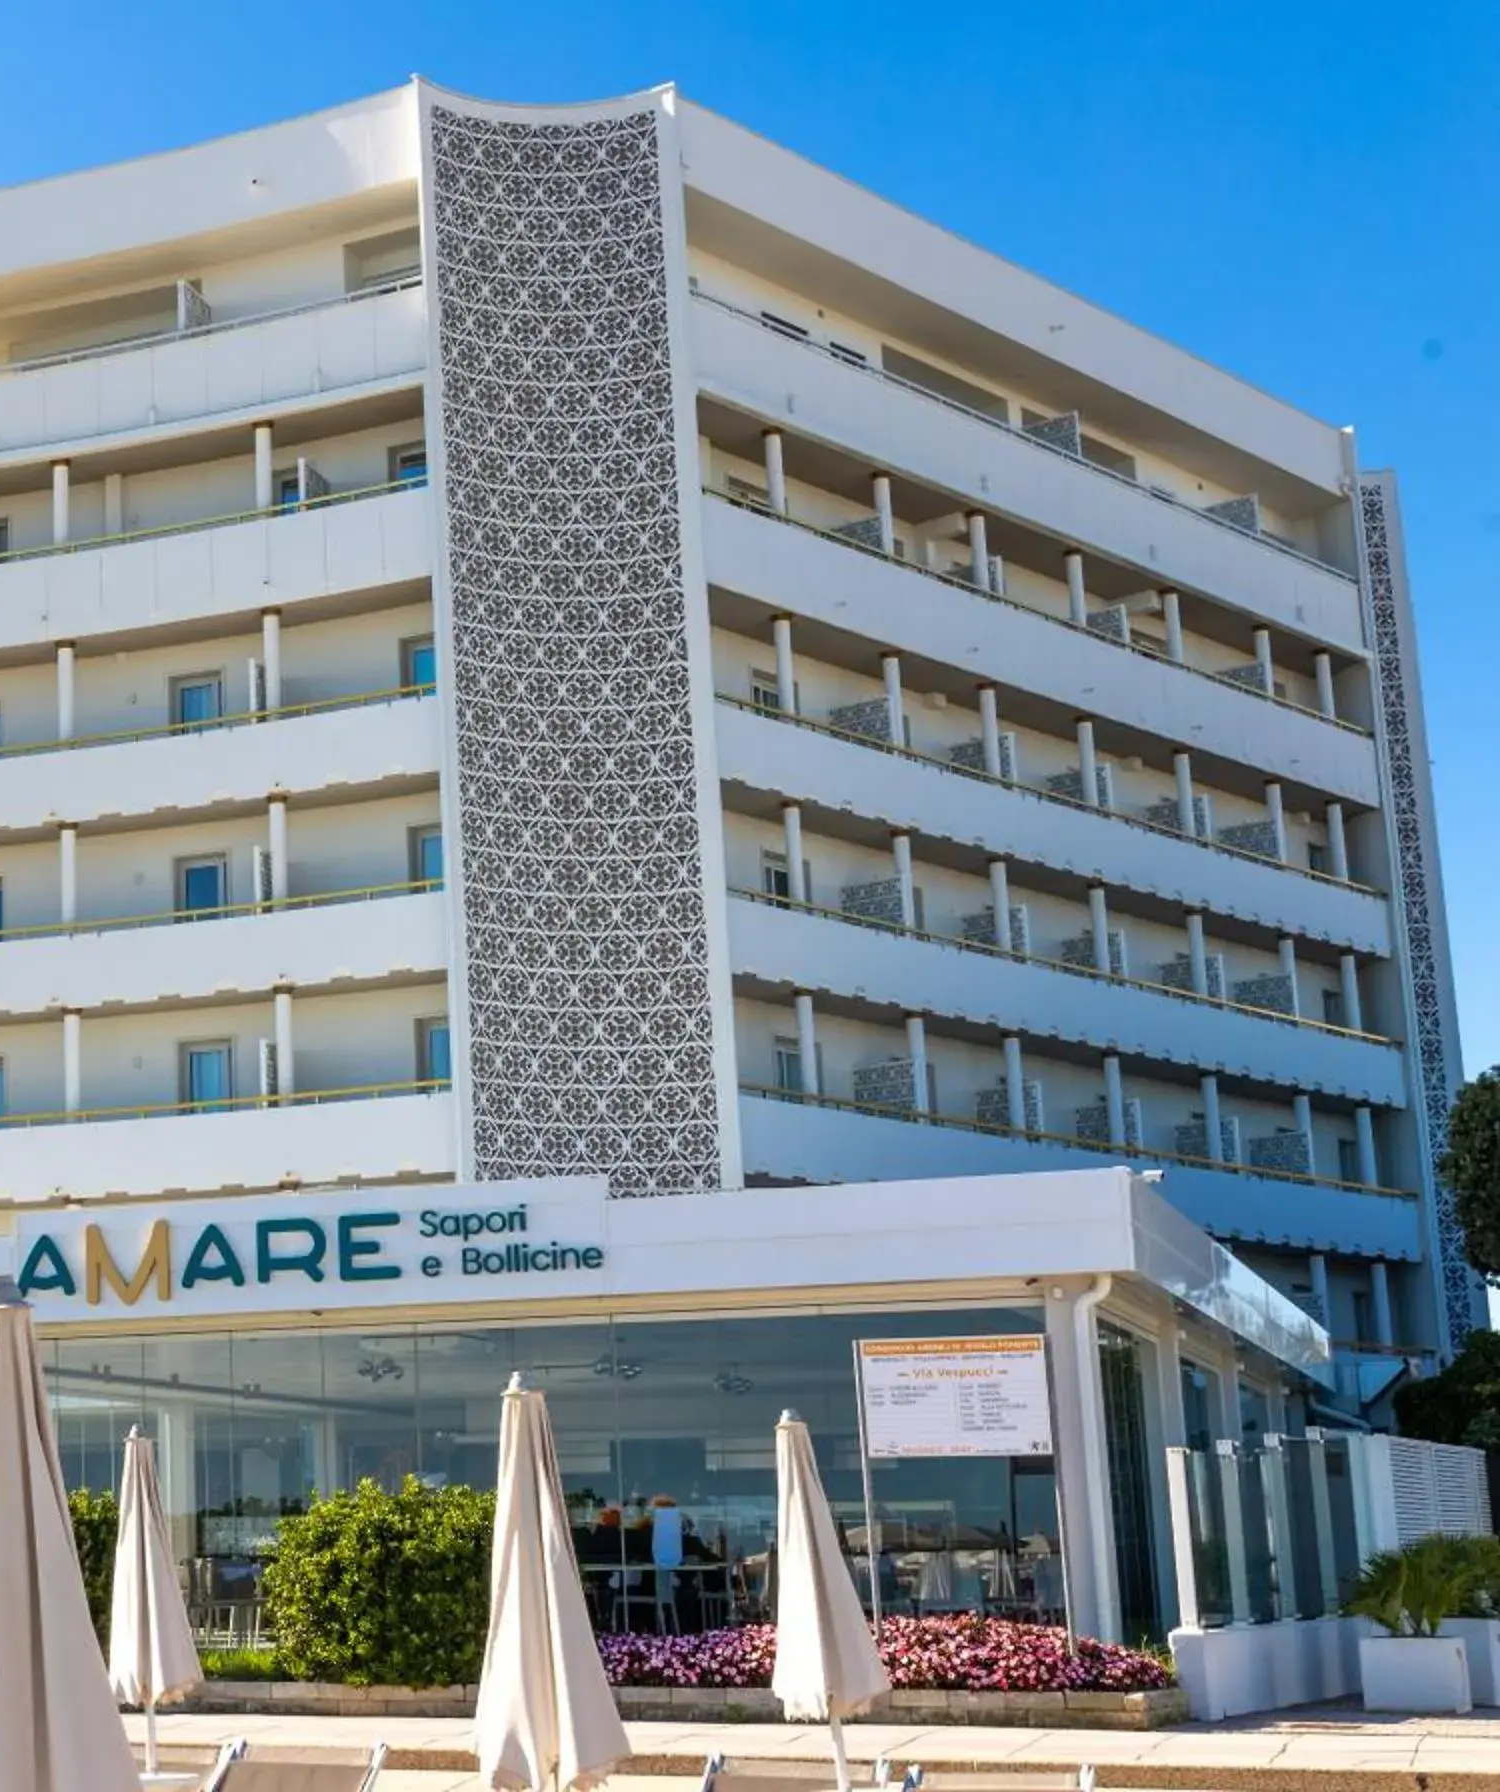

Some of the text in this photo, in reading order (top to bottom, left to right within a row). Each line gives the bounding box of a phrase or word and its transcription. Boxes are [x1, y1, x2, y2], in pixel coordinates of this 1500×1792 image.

[419, 1204, 527, 1241] Sapori
[17, 1213, 401, 1306] AMARE
[421, 1241, 604, 1277] e Bollicine
[912, 1367, 934, 1378] Via
